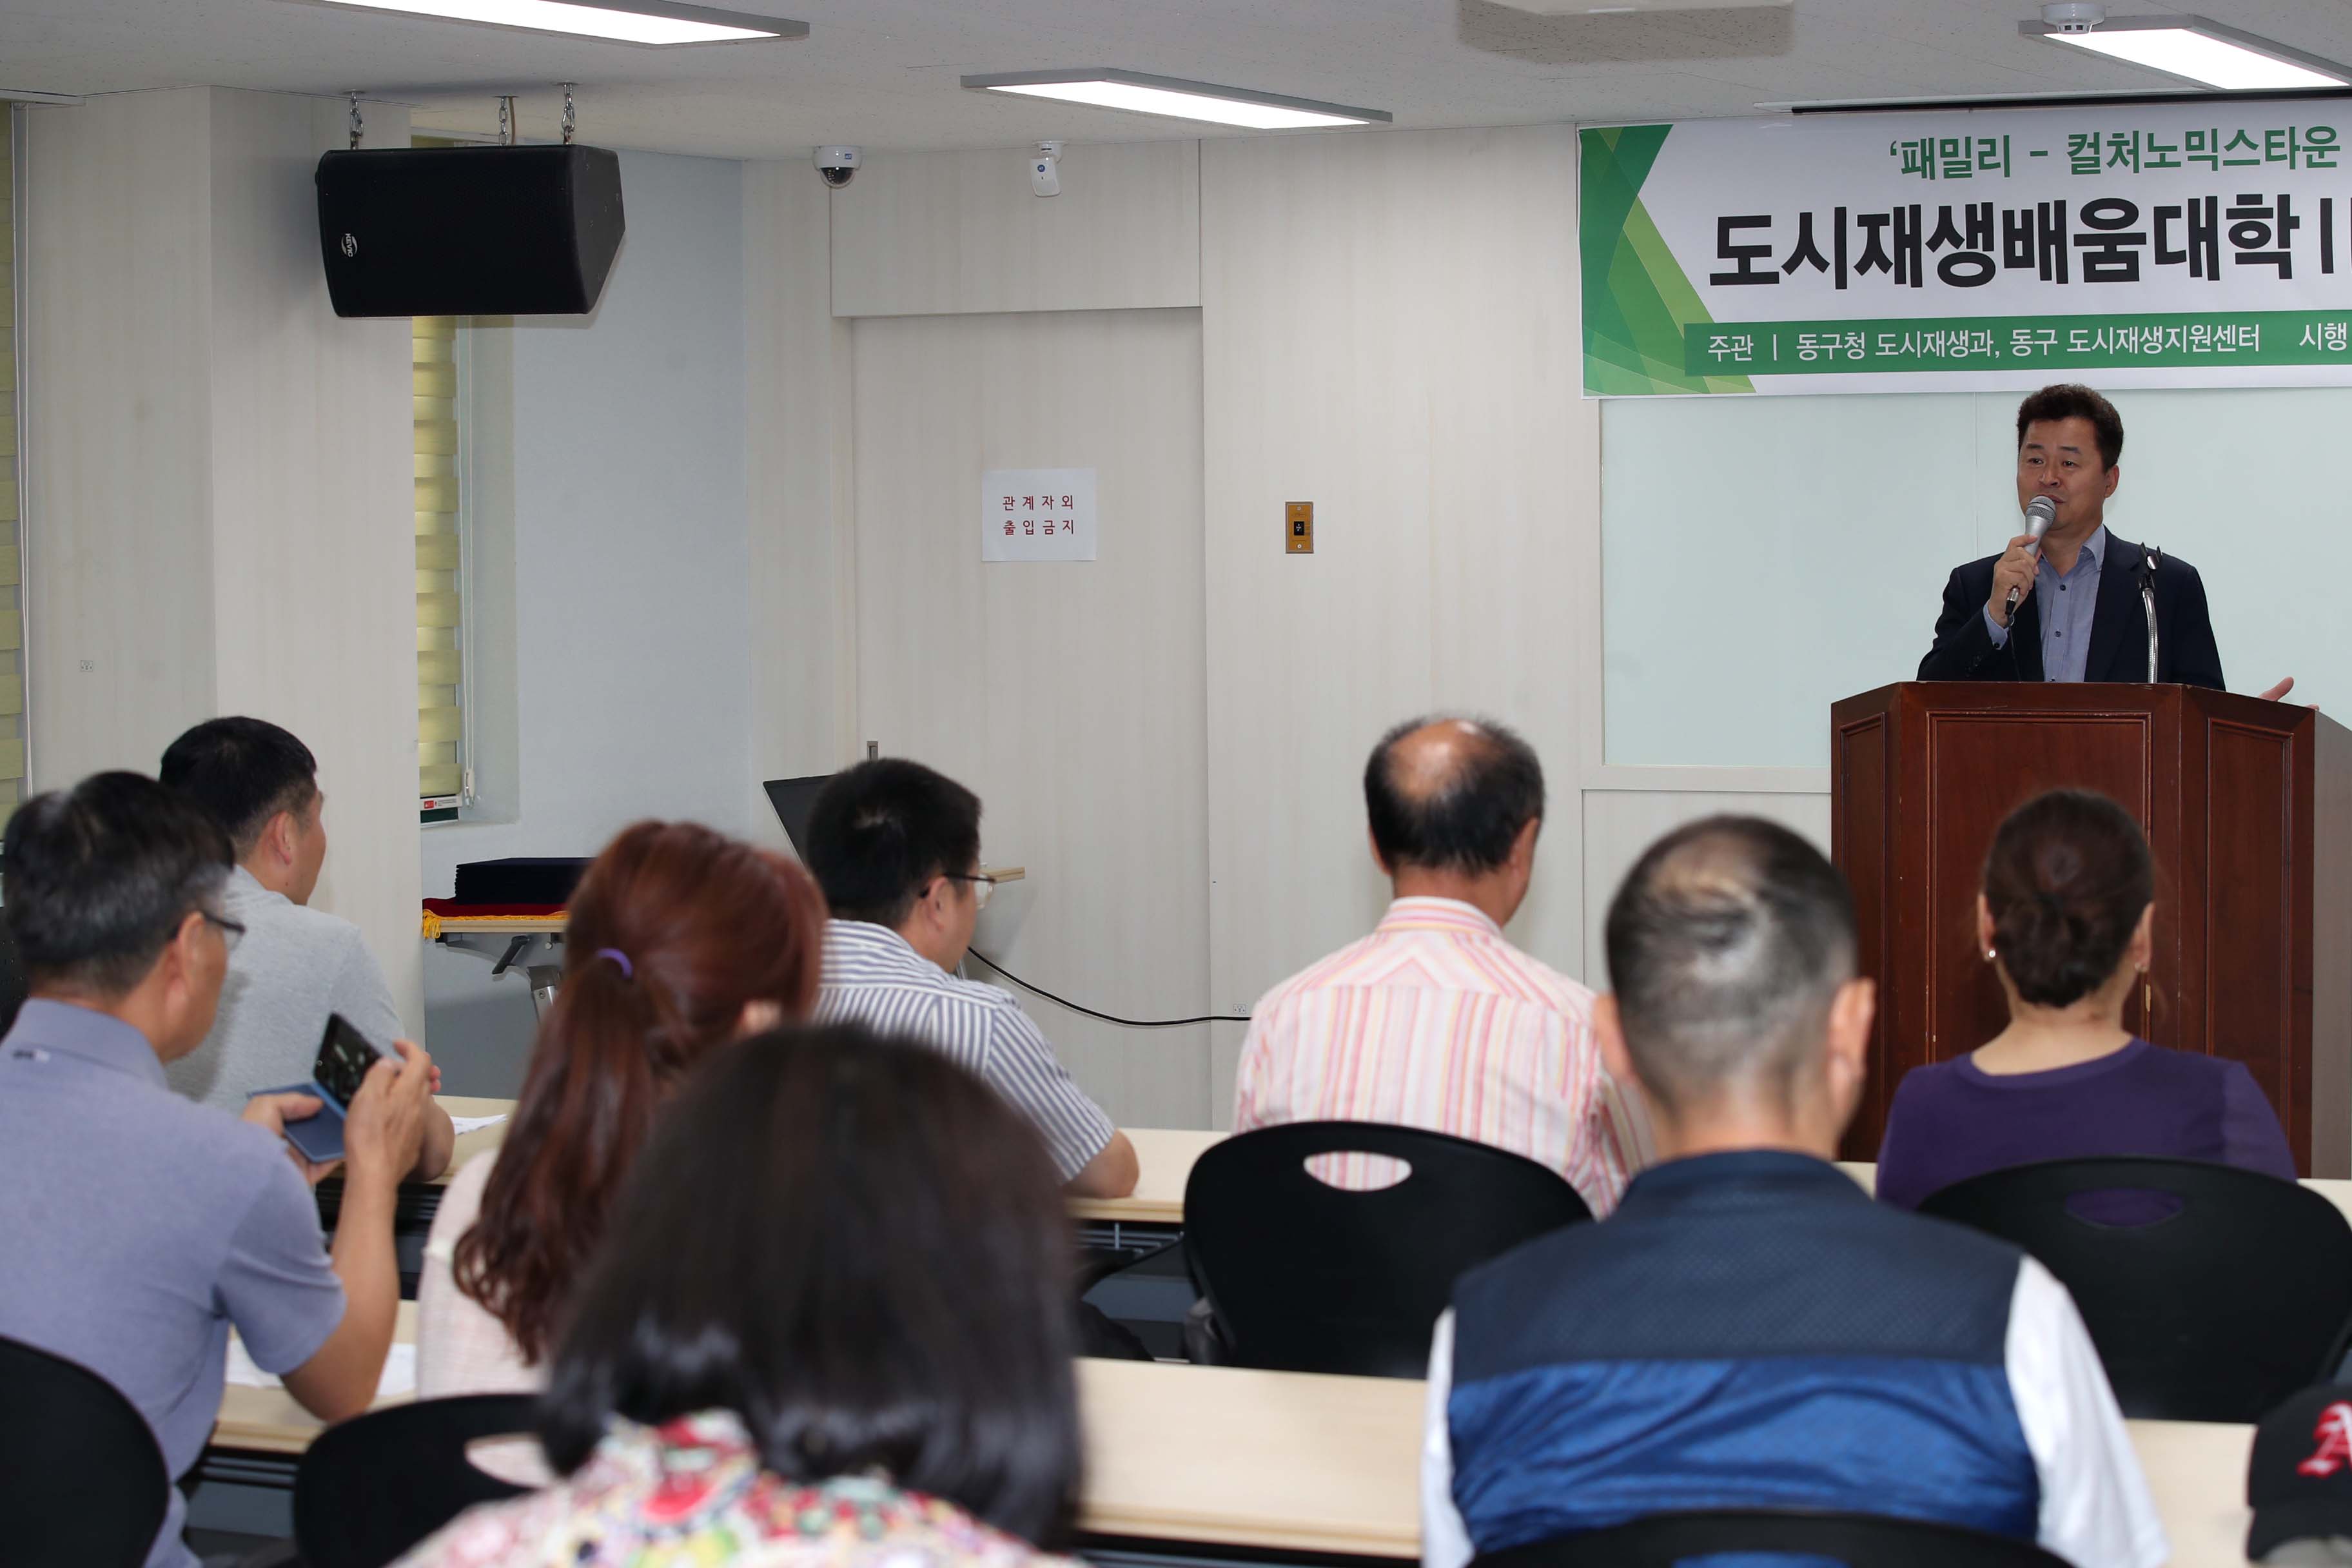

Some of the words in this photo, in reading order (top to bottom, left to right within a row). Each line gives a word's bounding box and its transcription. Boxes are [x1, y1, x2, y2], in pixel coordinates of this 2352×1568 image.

[2067, 126, 2341, 175] 컬처노믹스타운
[1709, 193, 2300, 290] 도시재생배움대학
[1708, 334, 1754, 362] 주관
[1796, 332, 1866, 360] 동구청
[1875, 329, 2000, 358] 도시재생과,
[2010, 329, 2057, 357] 동구
[2066, 324, 2260, 355] 도시재생지원센터
[2299, 322, 2347, 351] 시행
